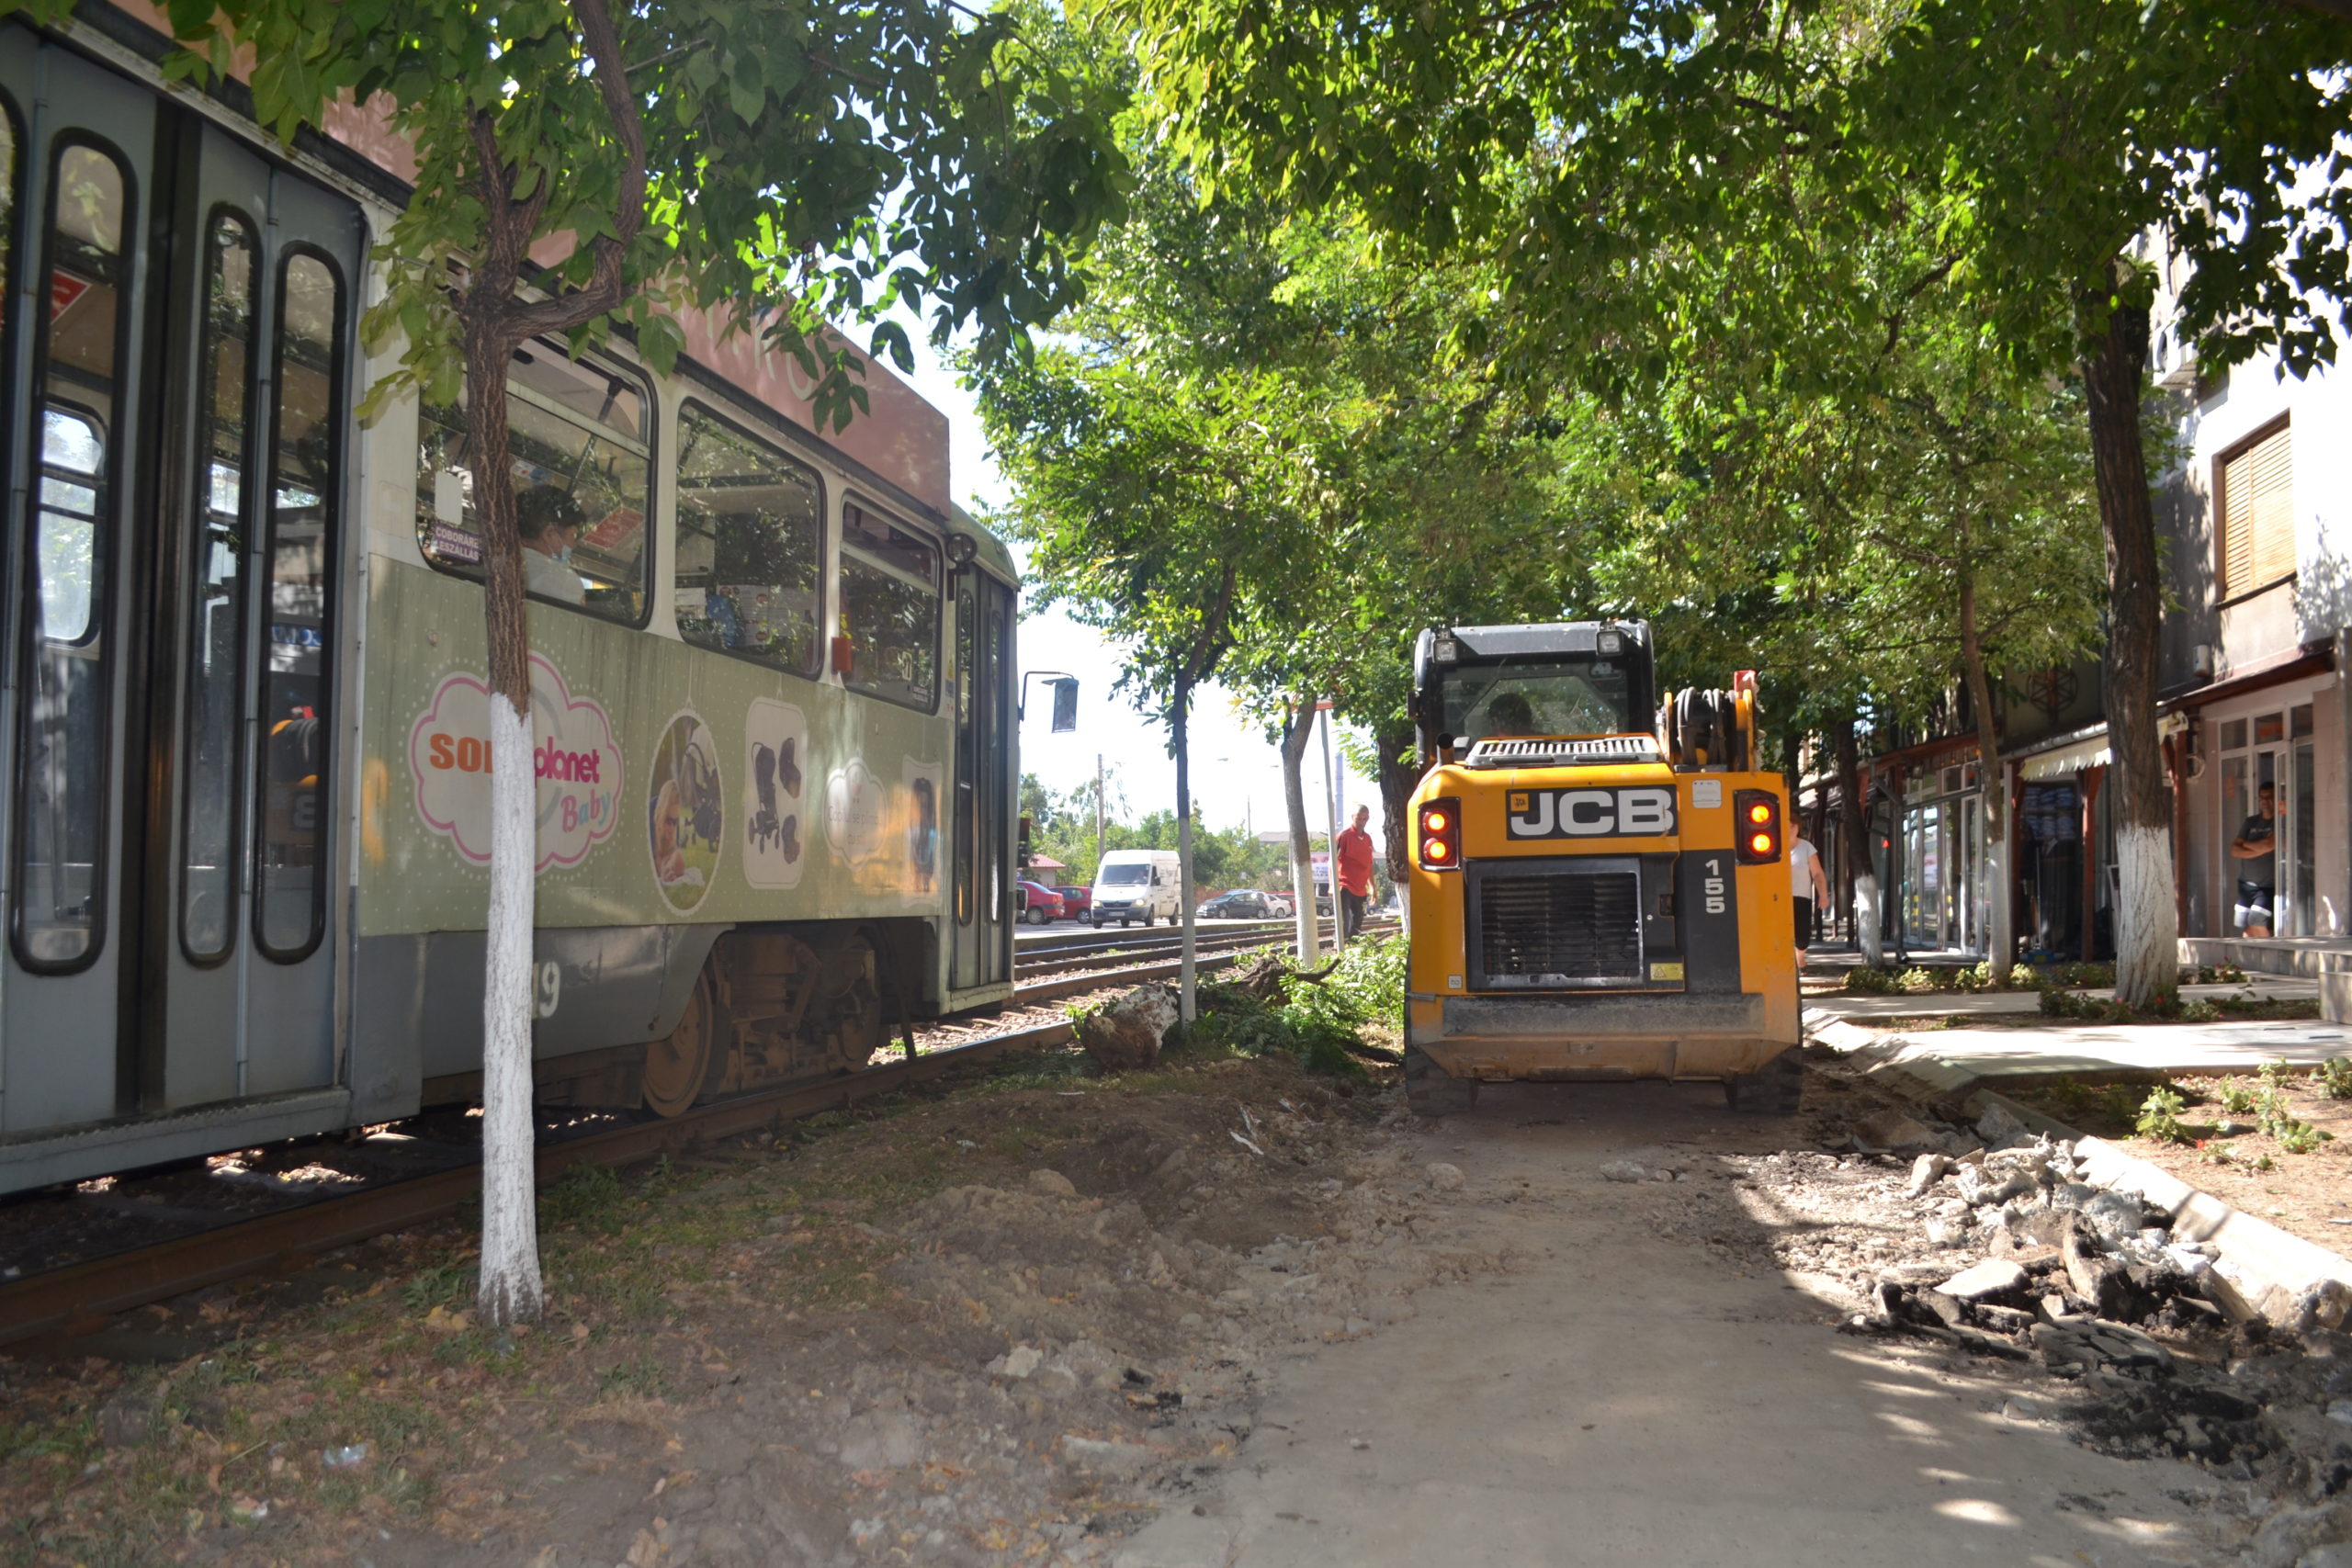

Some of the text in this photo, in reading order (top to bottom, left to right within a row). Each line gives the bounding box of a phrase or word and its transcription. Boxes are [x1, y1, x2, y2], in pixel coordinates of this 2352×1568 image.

[560, 788, 611, 833] Baby
[1510, 788, 1674, 836] JCB
[1704, 859, 1725, 914] 155
